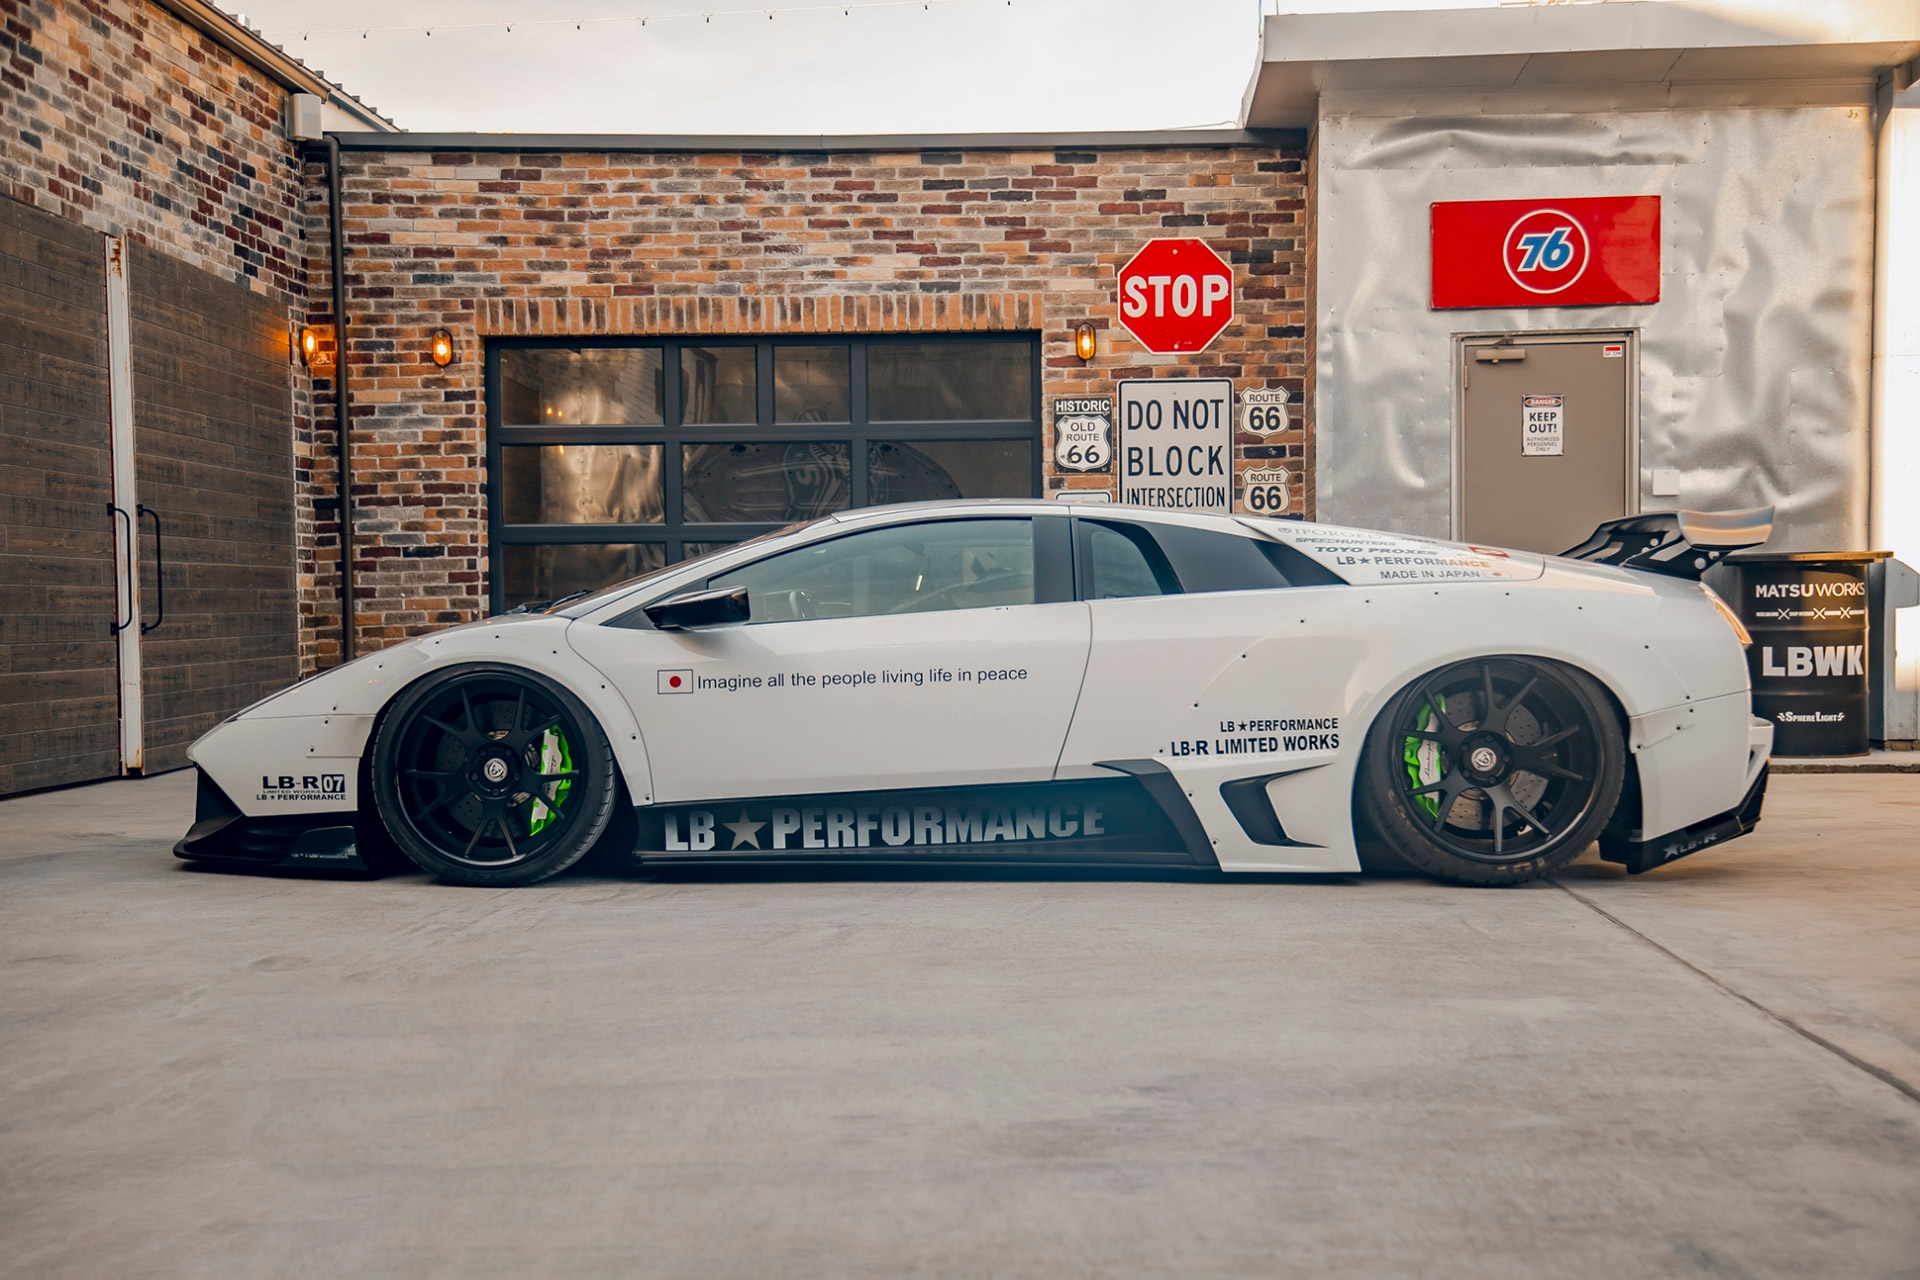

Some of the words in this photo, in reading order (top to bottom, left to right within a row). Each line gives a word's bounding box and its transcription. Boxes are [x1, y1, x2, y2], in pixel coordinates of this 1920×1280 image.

[1516, 226, 1574, 272] 76
[1123, 275, 1229, 318] STOP
[1055, 400, 1110, 413] HISTORIC
[1249, 394, 1280, 403] ROUTE
[1127, 400, 1162, 430] DO
[1173, 399, 1224, 430] NOT
[1249, 406, 1281, 431] 66
[1529, 412, 1557, 421] KEEP
[1070, 422, 1096, 432] OLD
[1529, 423, 1557, 433] OUT!
[1066, 433, 1100, 442] ROUTE
[1067, 445, 1100, 464] 66
[1127, 445, 1225, 476] BLOCK
[1250, 473, 1282, 482] ROUTE
[1126, 486, 1226, 508] INTERSECTION
[1249, 486, 1282, 511] 66
[1295, 537, 1397, 546] SPEEDHUNTERS
[1368, 547, 1438, 556] PROXES
[1337, 556, 1356, 565] LB
[1374, 556, 1490, 568] PERFORMANCE
[1381, 570, 1418, 579] MADE
[1421, 570, 1434, 578] IN
[1438, 570, 1481, 578] JAPAN
[1762, 645, 1864, 677] LBWK
[697, 675, 762, 692] Imagine
[767, 674, 785, 688] all
[791, 673, 817, 687] the
[822, 671, 877, 689] people
[882, 670, 924, 687] living
[929, 668, 953, 683] life
[958, 668, 972, 682] in
[977, 667, 1028, 684] peace
[1220, 721, 1235, 732] LB
[1249, 718, 1339, 732] PERFORMANCE
[1171, 740, 1209, 757] LB-R
[1216, 737, 1278, 755] LIMITED
[1283, 733, 1340, 751] WORKS
[262, 776, 319, 789] LB-R
[323, 776, 344, 792] 07
[664, 810, 715, 852] LB
[772, 804, 1105, 850] PERFORMANCE
[1679, 832, 1717, 853] LB-R
